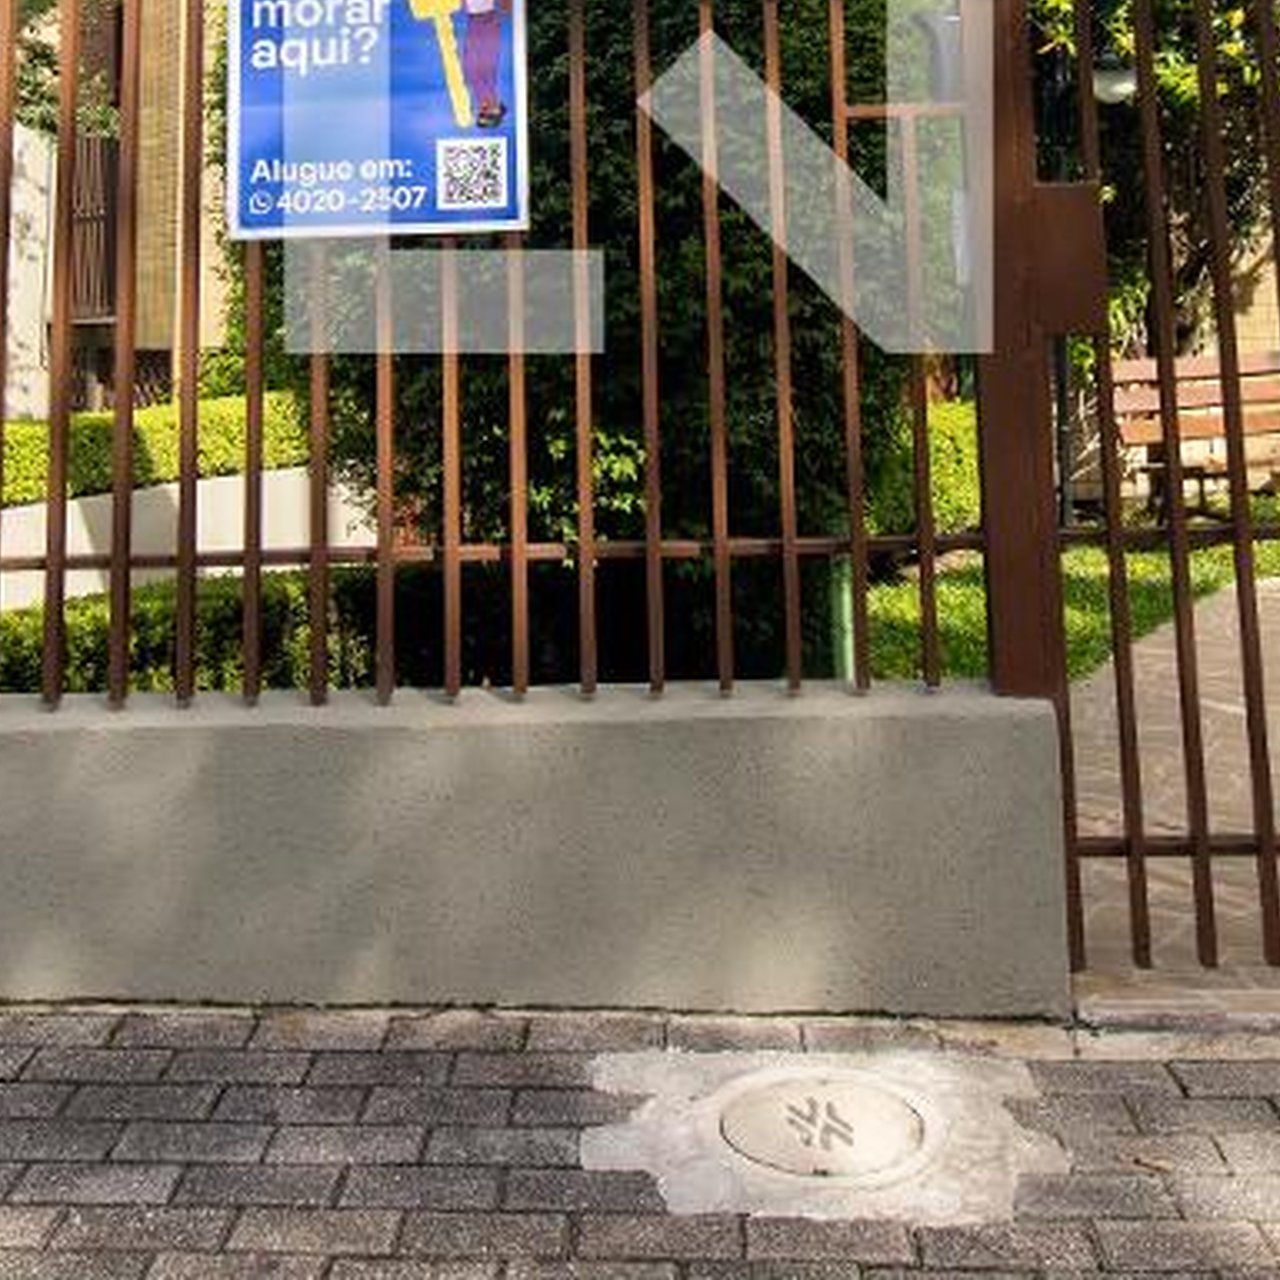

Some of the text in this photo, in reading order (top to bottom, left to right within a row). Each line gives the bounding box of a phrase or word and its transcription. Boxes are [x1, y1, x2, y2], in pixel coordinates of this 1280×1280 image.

[252, 27, 379, 77] aqui?
[250, 158, 413, 188] Alugue em:
